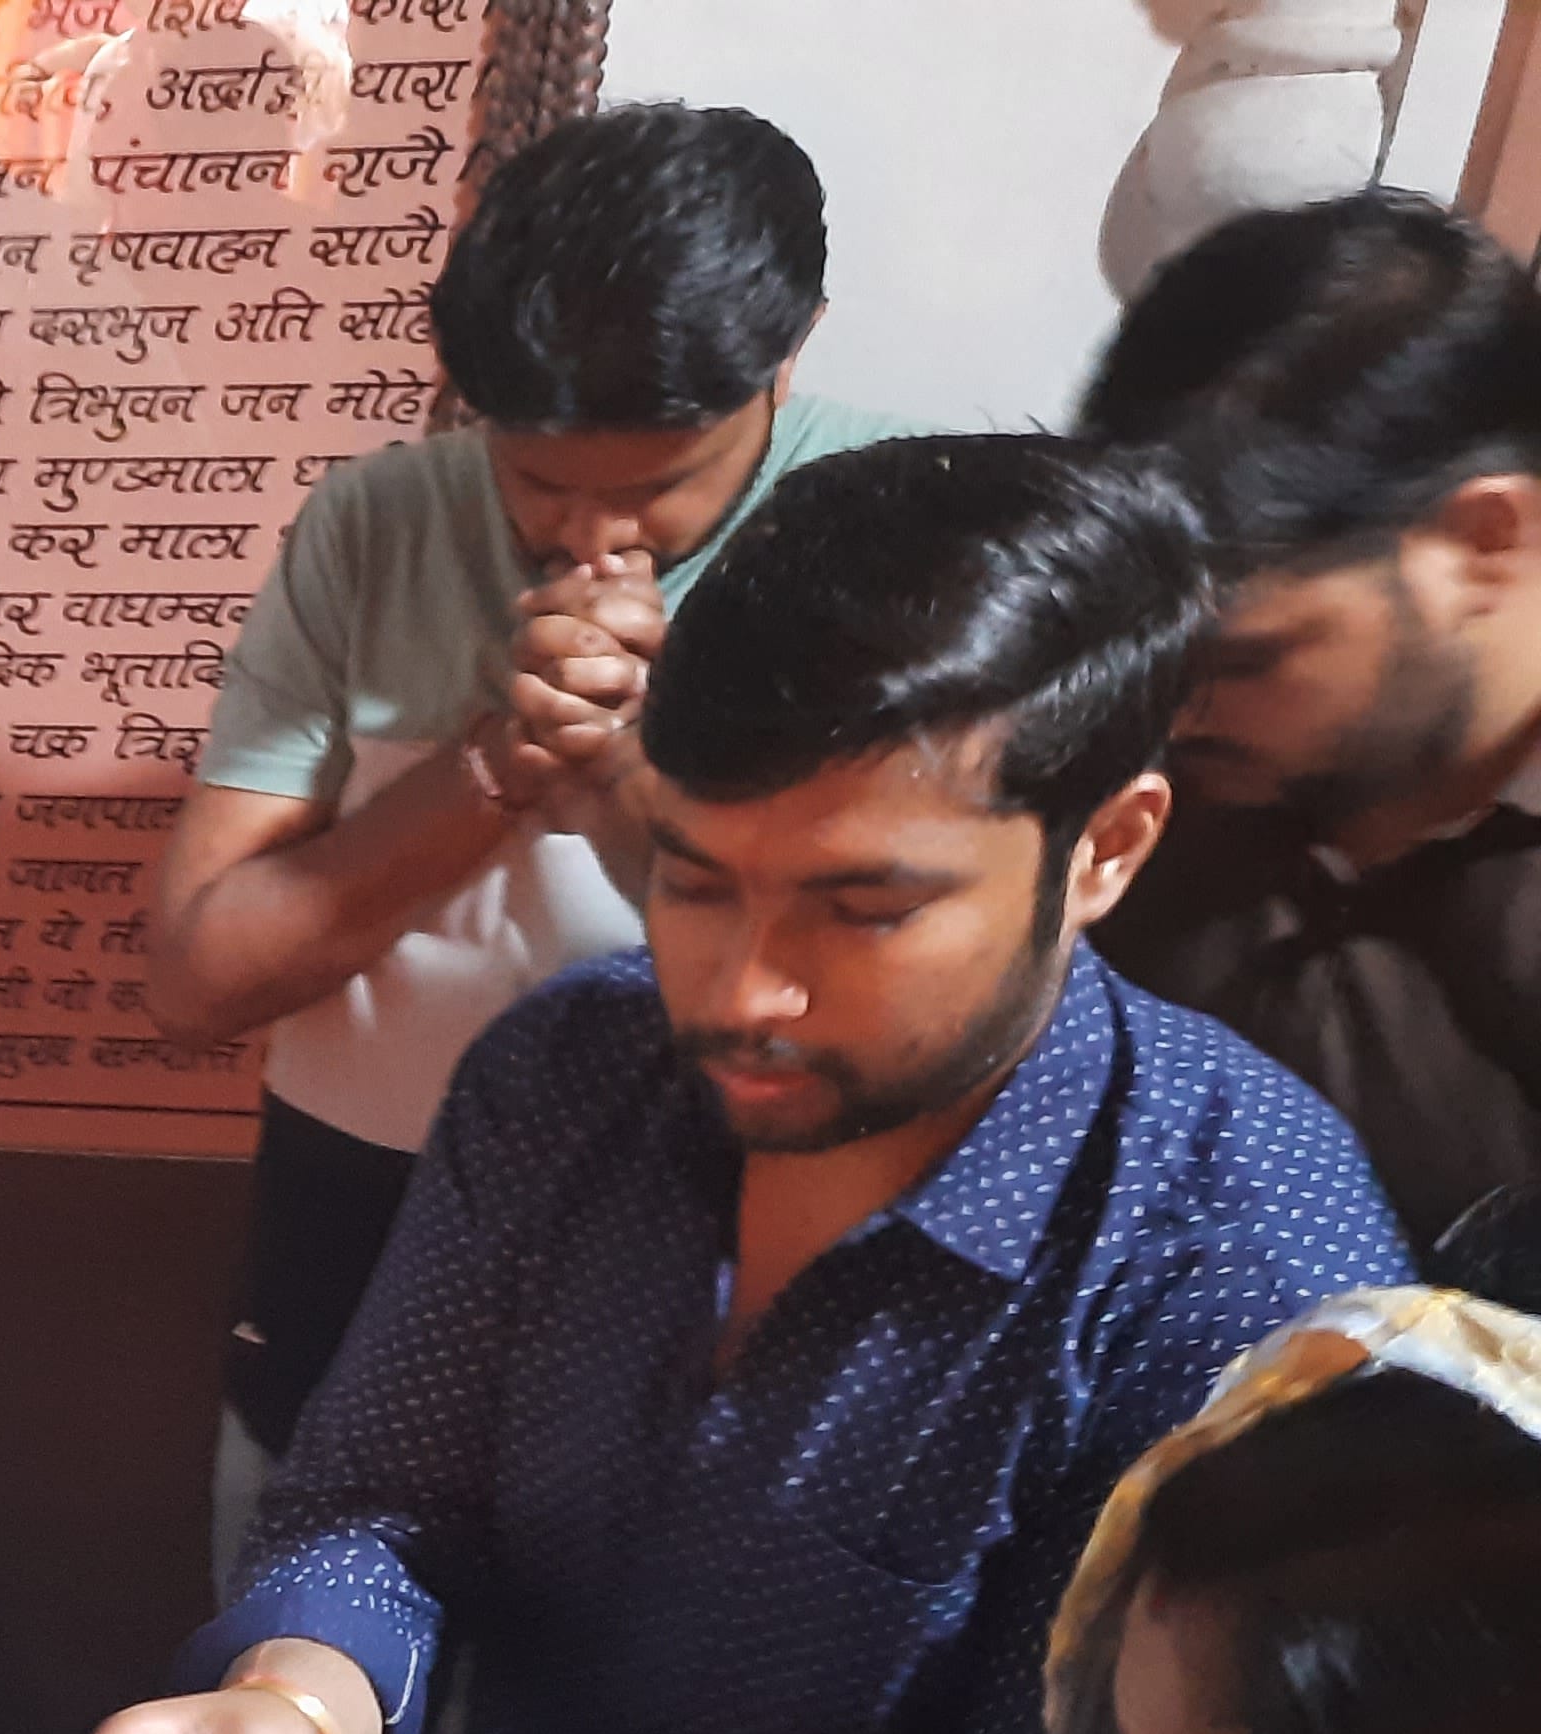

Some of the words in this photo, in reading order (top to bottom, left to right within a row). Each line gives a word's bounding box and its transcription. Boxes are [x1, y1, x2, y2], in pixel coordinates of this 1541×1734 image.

[89, 137, 303, 194] पंचानन
[309, 205, 447, 267] साजै
[214, 286, 325, 344] अति
[28, 371, 207, 441] त्रिभुवन
[221, 381, 311, 423] जन
[326, 368, 435, 424] मोहे
[9, 523, 109, 569] कर
[119, 523, 259, 561] माला
[80, 639, 225, 706] भूतादि
[9, 724, 99, 760] चक्र
